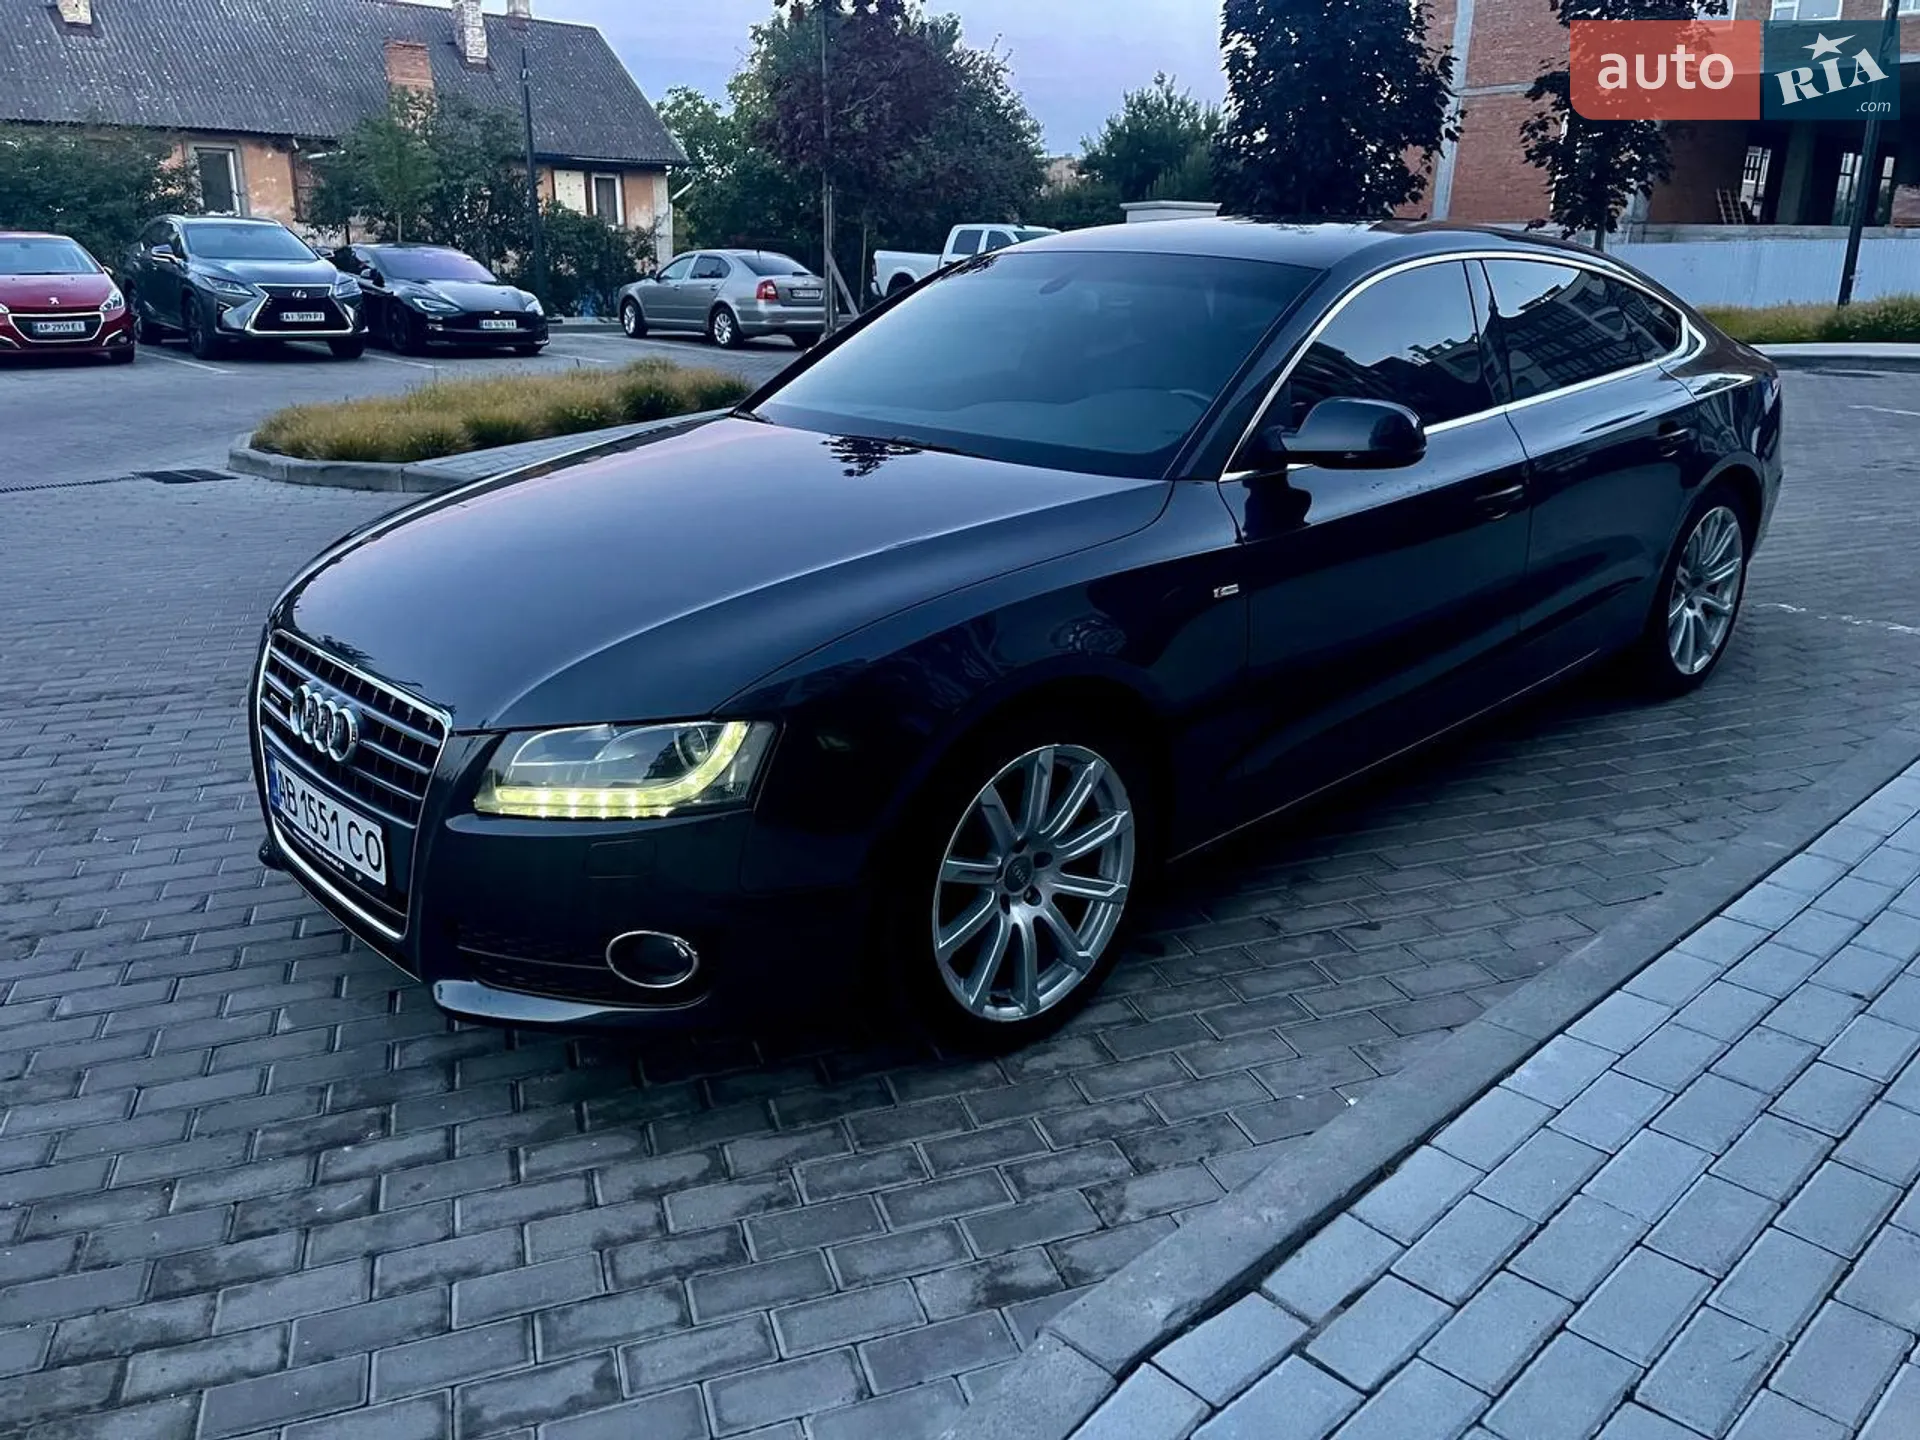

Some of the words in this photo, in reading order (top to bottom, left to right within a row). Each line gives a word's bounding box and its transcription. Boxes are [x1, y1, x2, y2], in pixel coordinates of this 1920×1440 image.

[278, 768, 297, 817] AB
[300, 790, 341, 851] 1551
[347, 820, 381, 872] CO
